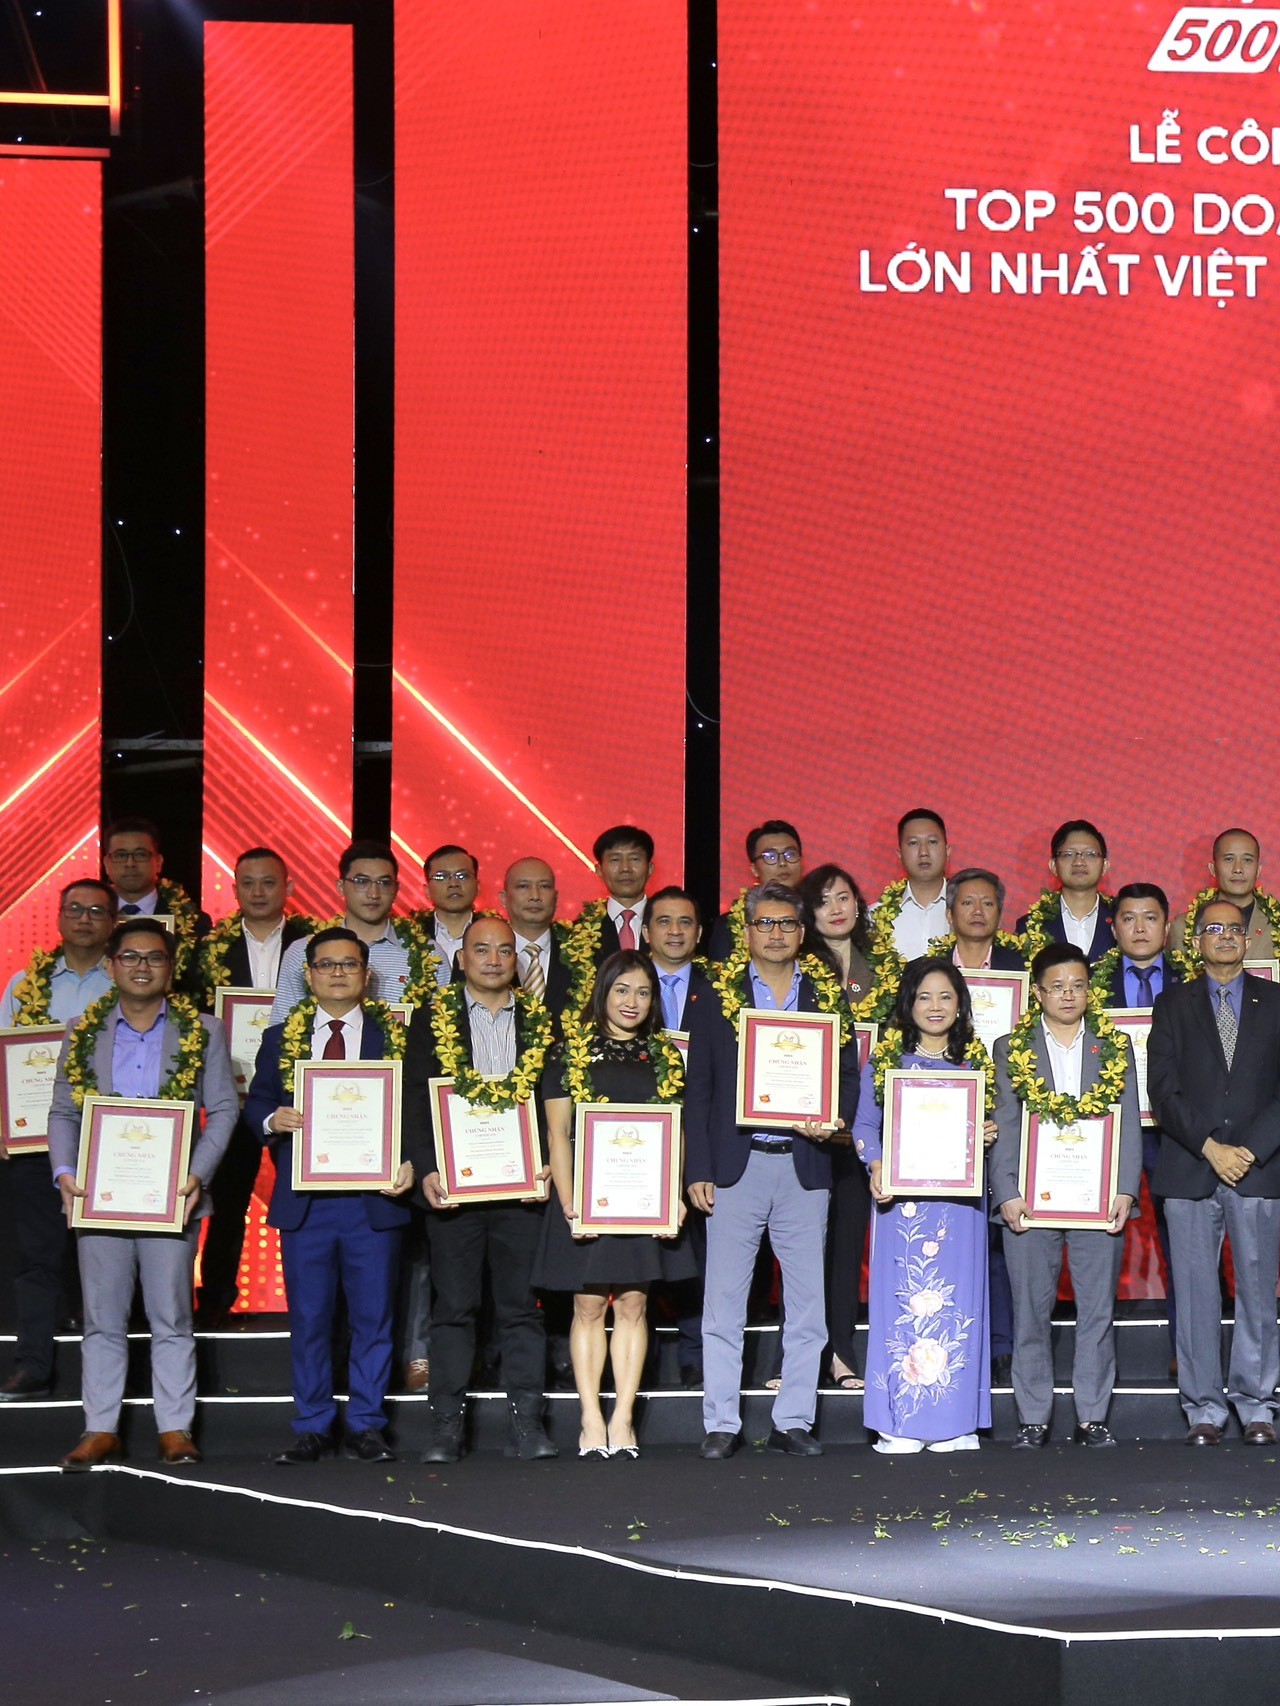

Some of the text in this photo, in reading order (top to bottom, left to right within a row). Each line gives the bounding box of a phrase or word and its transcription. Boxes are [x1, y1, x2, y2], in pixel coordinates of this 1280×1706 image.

[1166, 19, 1279, 63] 500
[1129, 108, 1182, 164] LỄ
[944, 188, 1056, 232] TOP
[1073, 191, 1175, 234] 500
[859, 241, 971, 294] LỚN
[990, 242, 1141, 296] NHẤT
[1153, 247, 1268, 308] VIỆT
